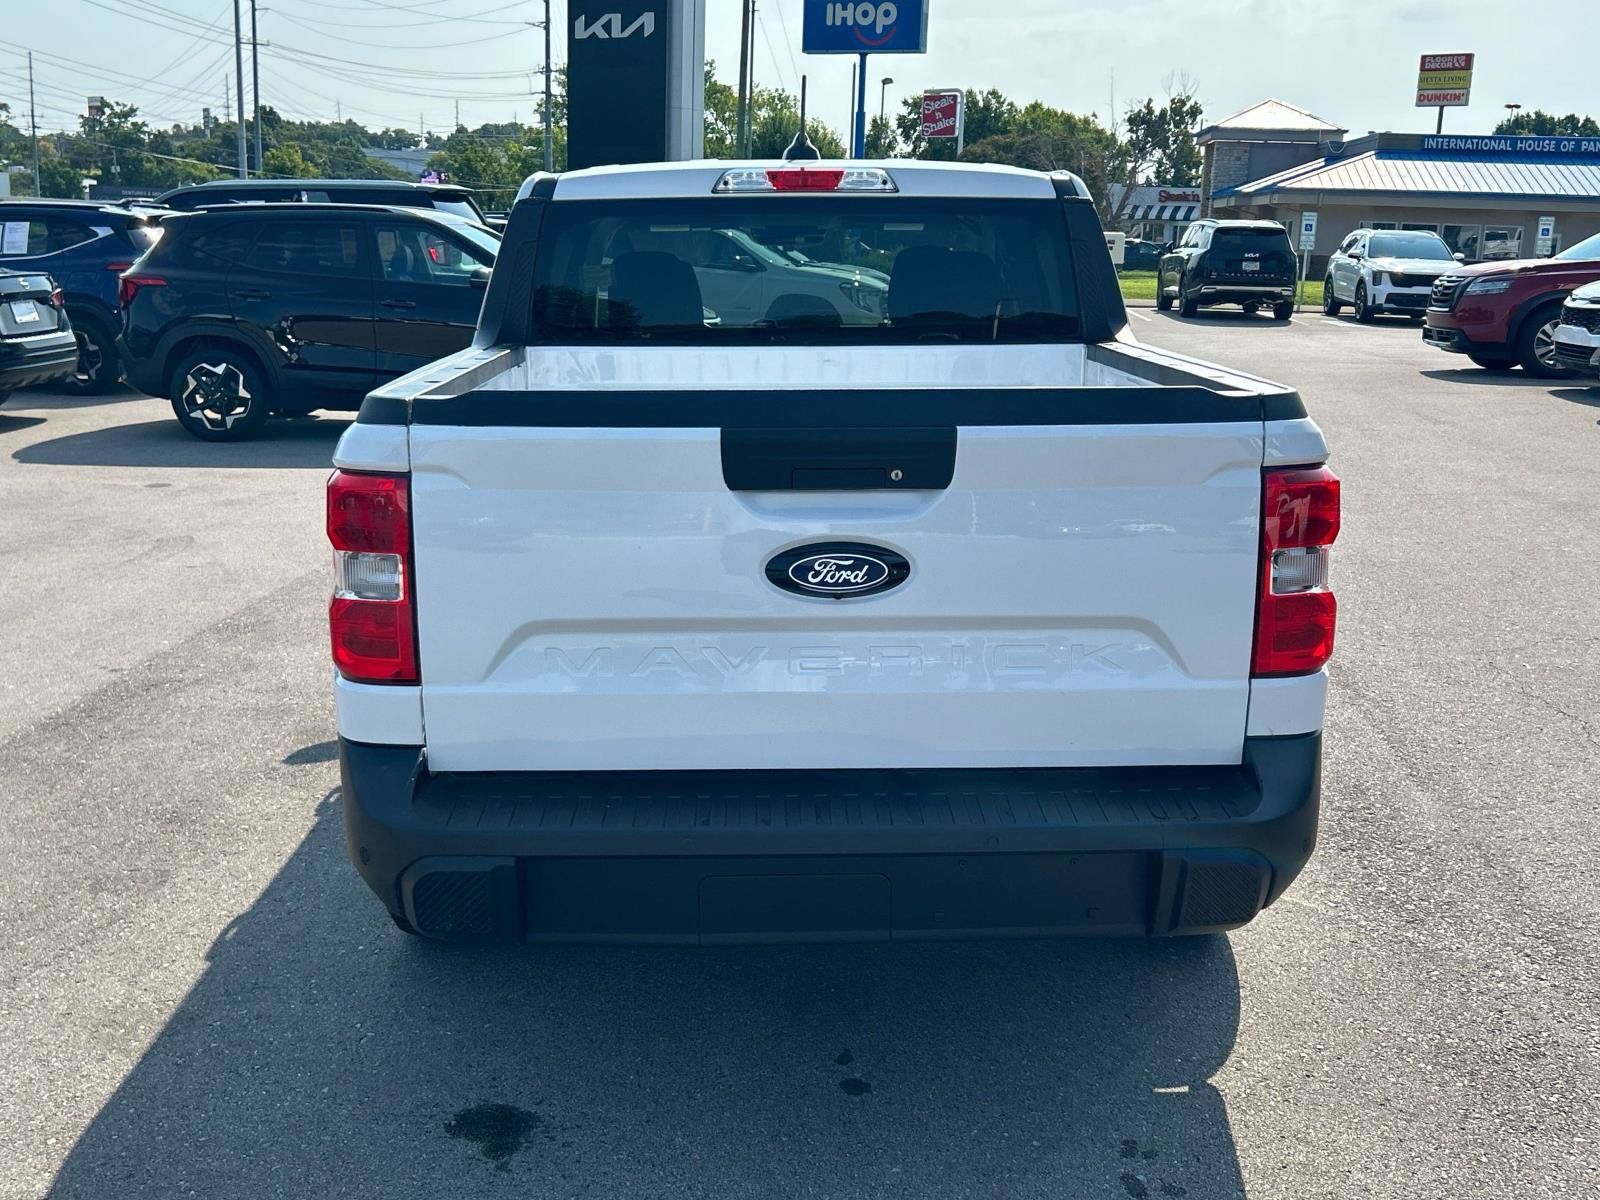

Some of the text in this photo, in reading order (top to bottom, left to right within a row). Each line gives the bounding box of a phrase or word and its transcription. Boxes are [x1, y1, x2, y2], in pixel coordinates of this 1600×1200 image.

[574, 12, 655, 39] KIA
[826, 2, 898, 34] IHOP
[1444, 75, 1467, 83] LIVING
[923, 96, 954, 114] Steak
[1418, 93, 1465, 102] DUNKIN'
[922, 117, 956, 136] Shake
[1424, 138, 1512, 151] INTERNATIONAL
[1517, 139, 1556, 152] HOUSE
[1560, 140, 1576, 152] OF
[807, 558, 869, 584] Ford
[544, 642, 1126, 678] MAVERICK
